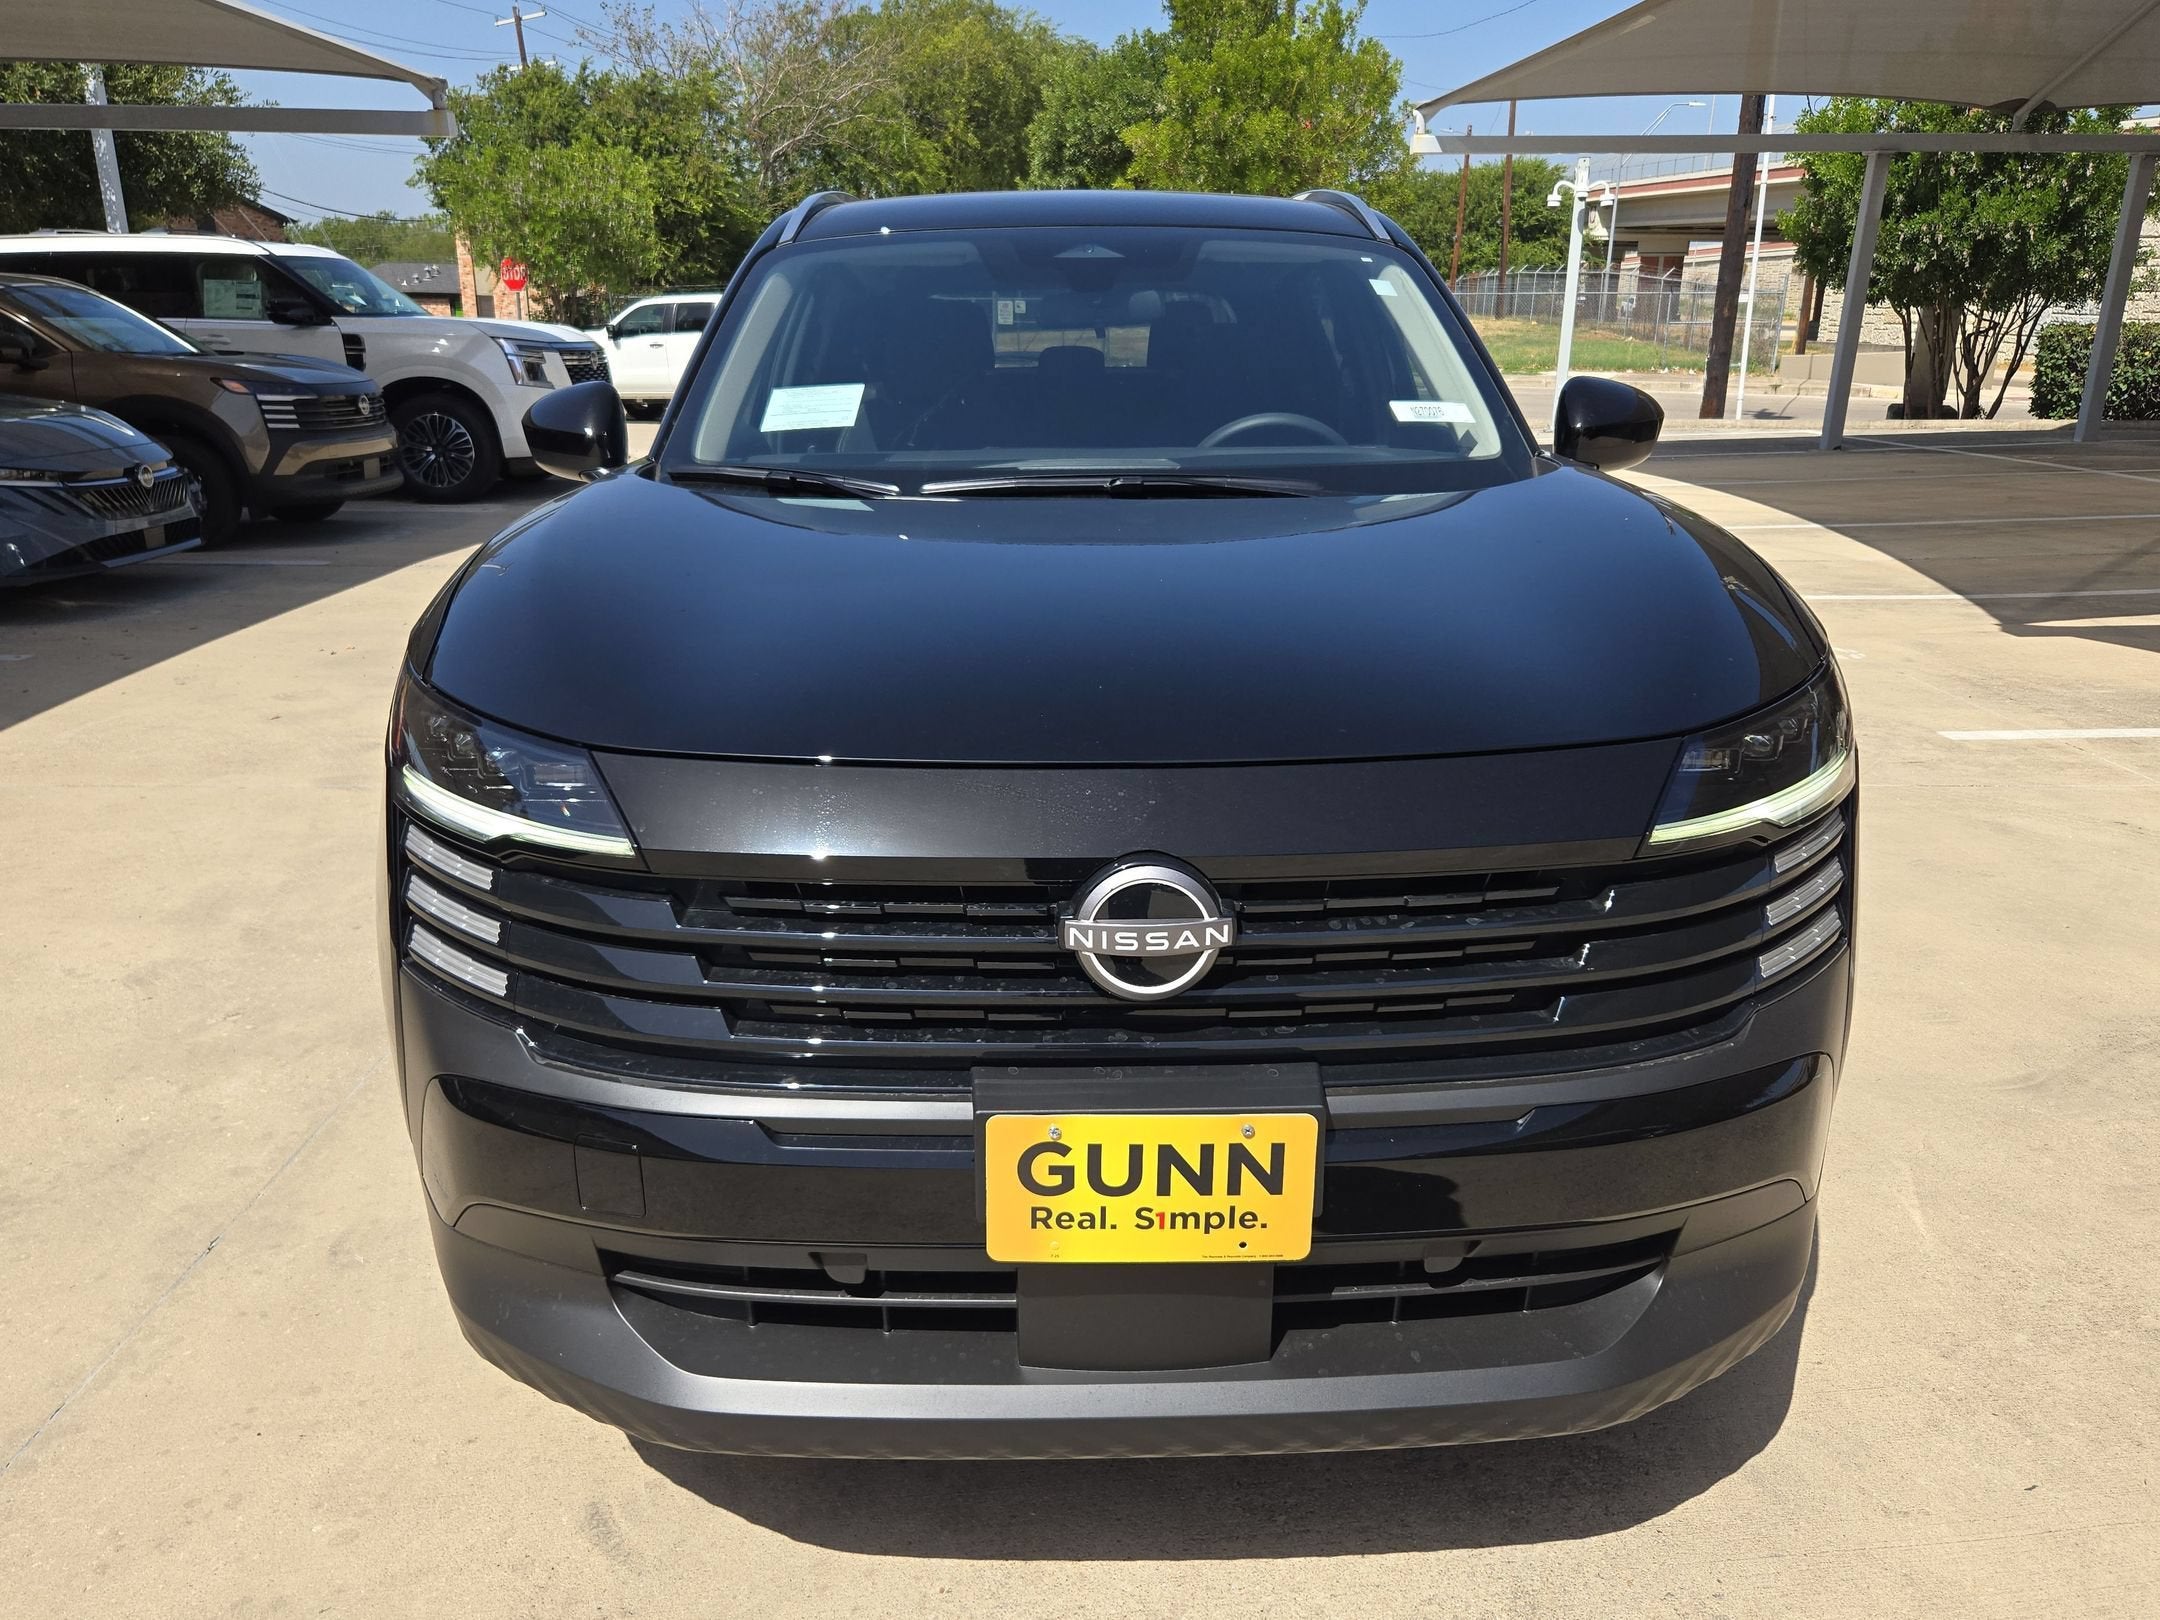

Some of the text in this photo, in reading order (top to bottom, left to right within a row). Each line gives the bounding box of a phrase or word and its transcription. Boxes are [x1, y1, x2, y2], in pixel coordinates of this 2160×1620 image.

[1069, 924, 1229, 951] NISSAN
[1017, 1140, 1286, 1197] GUNN
[1030, 1206, 1118, 1230] Real.
